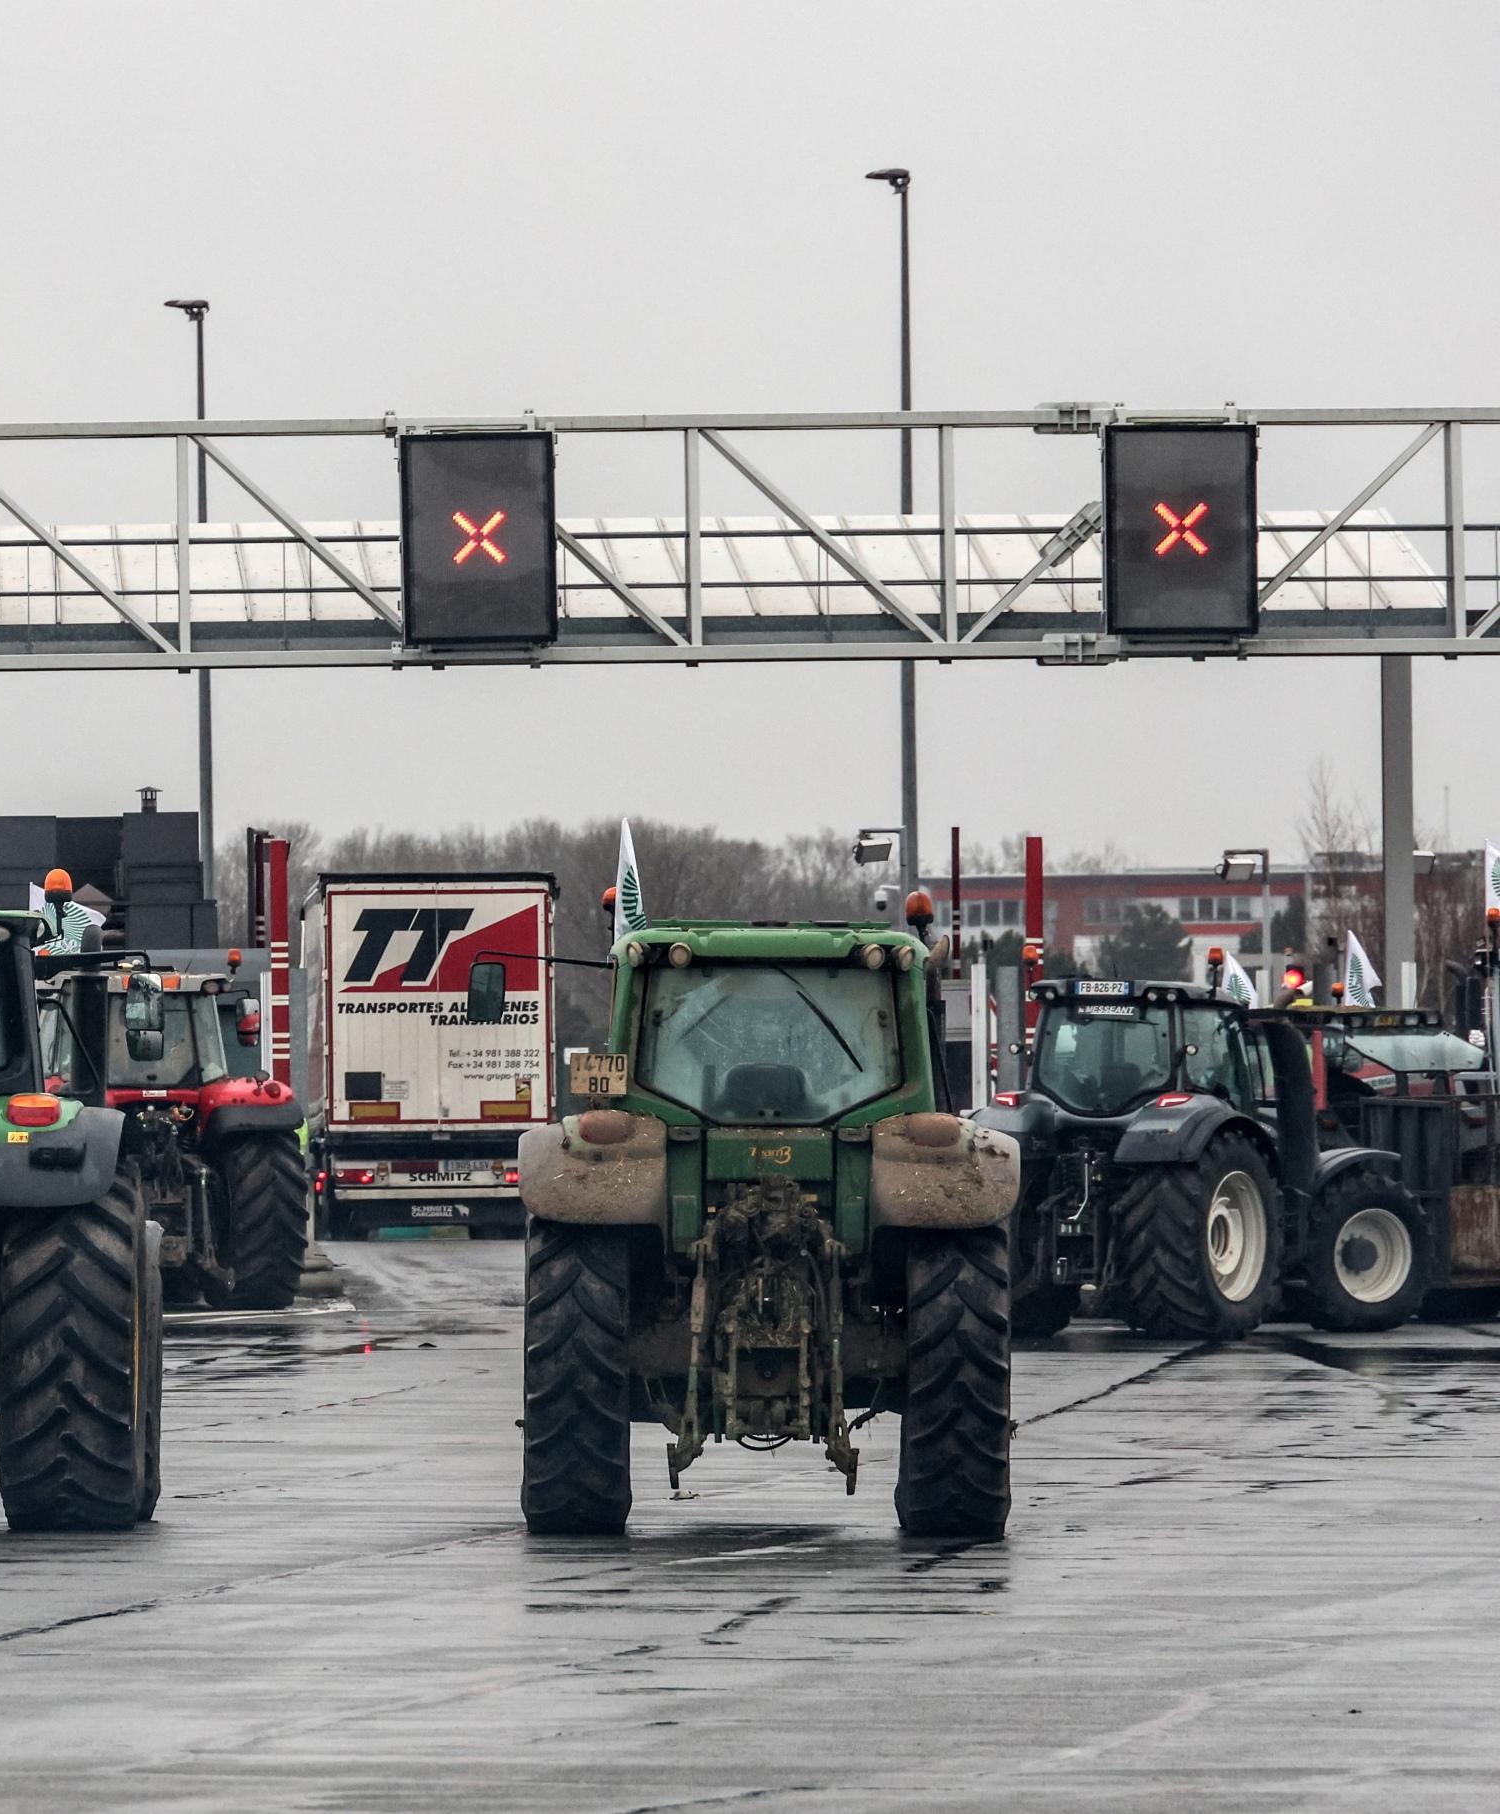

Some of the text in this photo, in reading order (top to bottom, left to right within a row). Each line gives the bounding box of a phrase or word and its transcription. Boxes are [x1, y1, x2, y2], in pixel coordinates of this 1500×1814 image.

[343, 908, 475, 982] TT
[337, 1001, 443, 1014] TRANSPORTES
[485, 1049, 501, 1058] 981
[504, 1049, 521, 1058] 388
[523, 1049, 540, 1058] 322
[485, 1060, 501, 1069] 981
[504, 1060, 521, 1069] 388
[523, 1060, 540, 1069] 754
[588, 1076, 610, 1093] 80
[409, 1172, 472, 1182] SCHMITZ
